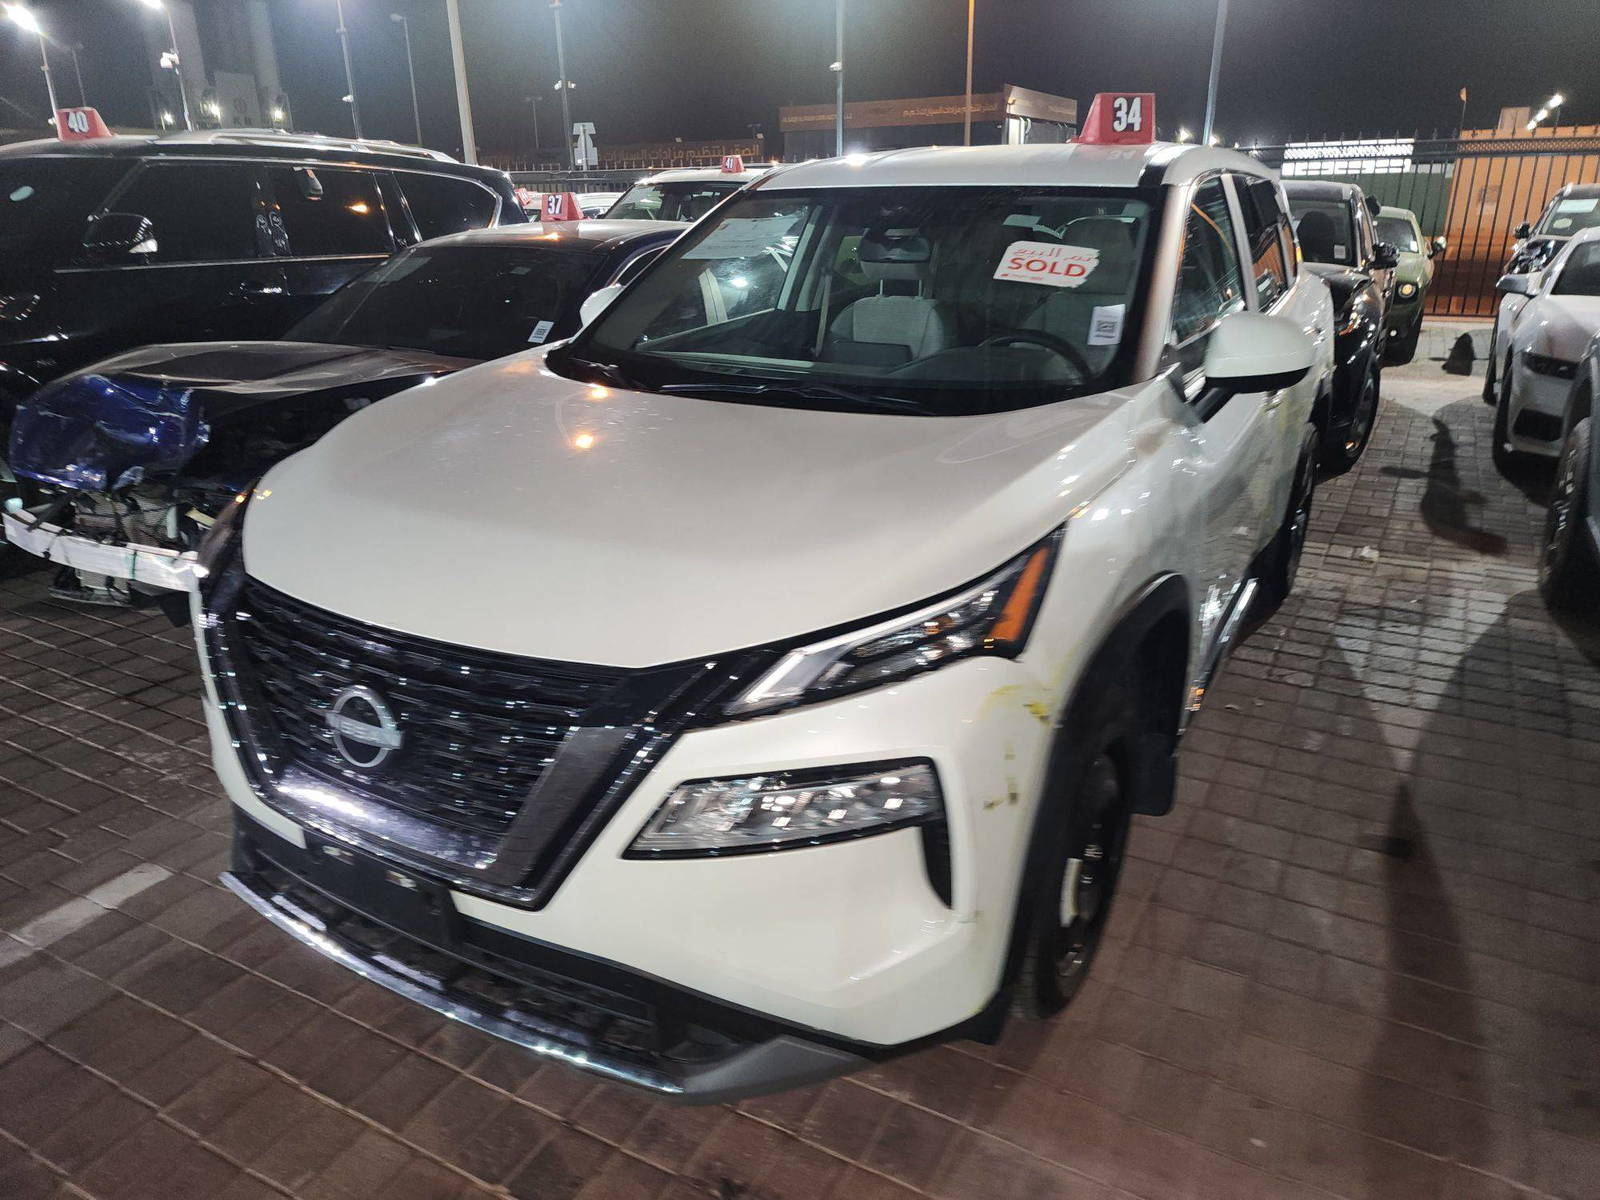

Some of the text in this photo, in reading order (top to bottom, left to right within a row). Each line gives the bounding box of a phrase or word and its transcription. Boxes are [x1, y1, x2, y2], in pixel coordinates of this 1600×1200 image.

[68, 111, 89, 133] 40
[1113, 96, 1142, 132] 34
[548, 195, 562, 214] 37
[1008, 257, 1087, 277] SOLD
